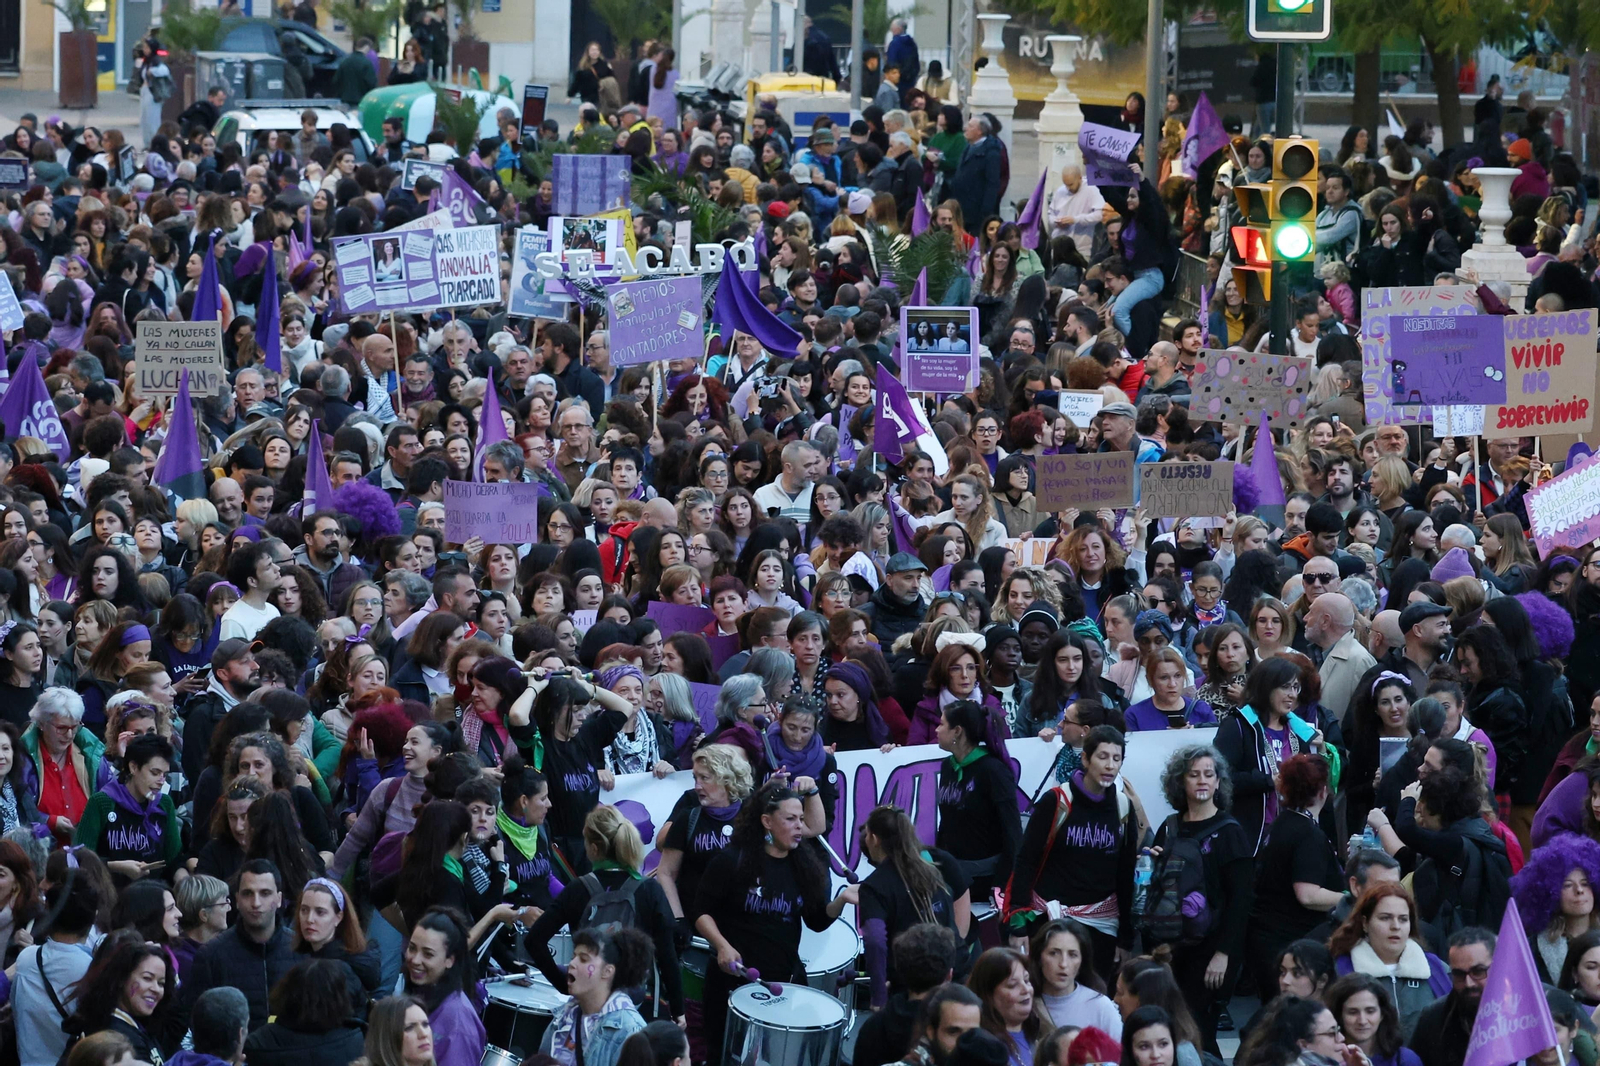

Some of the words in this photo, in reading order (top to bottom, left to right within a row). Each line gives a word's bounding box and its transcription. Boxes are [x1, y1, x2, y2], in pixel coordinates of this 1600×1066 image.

[1084, 130, 1096, 147] TE
[522, 234, 548, 244] FEMIN
[535, 249, 596, 280] SE
[440, 278, 495, 304] TRIARCADO
[632, 280, 676, 306] MEDIOS
[144, 326, 162, 338] LAS
[168, 328, 216, 338] MUJERES
[1505, 311, 1590, 340] UEREMOS
[146, 340, 160, 348] YA
[612, 328, 687, 364] CONTADORES
[144, 355, 162, 363] LAS
[170, 356, 214, 364] MUJERES
[142, 370, 208, 390] LUCHAN
[1522, 370, 1550, 394] NO
[1043, 460, 1066, 474] NO
[1160, 464, 1212, 480] RESPETO
[446, 482, 472, 498] MUCHO
[1568, 524, 1589, 546] 8M
